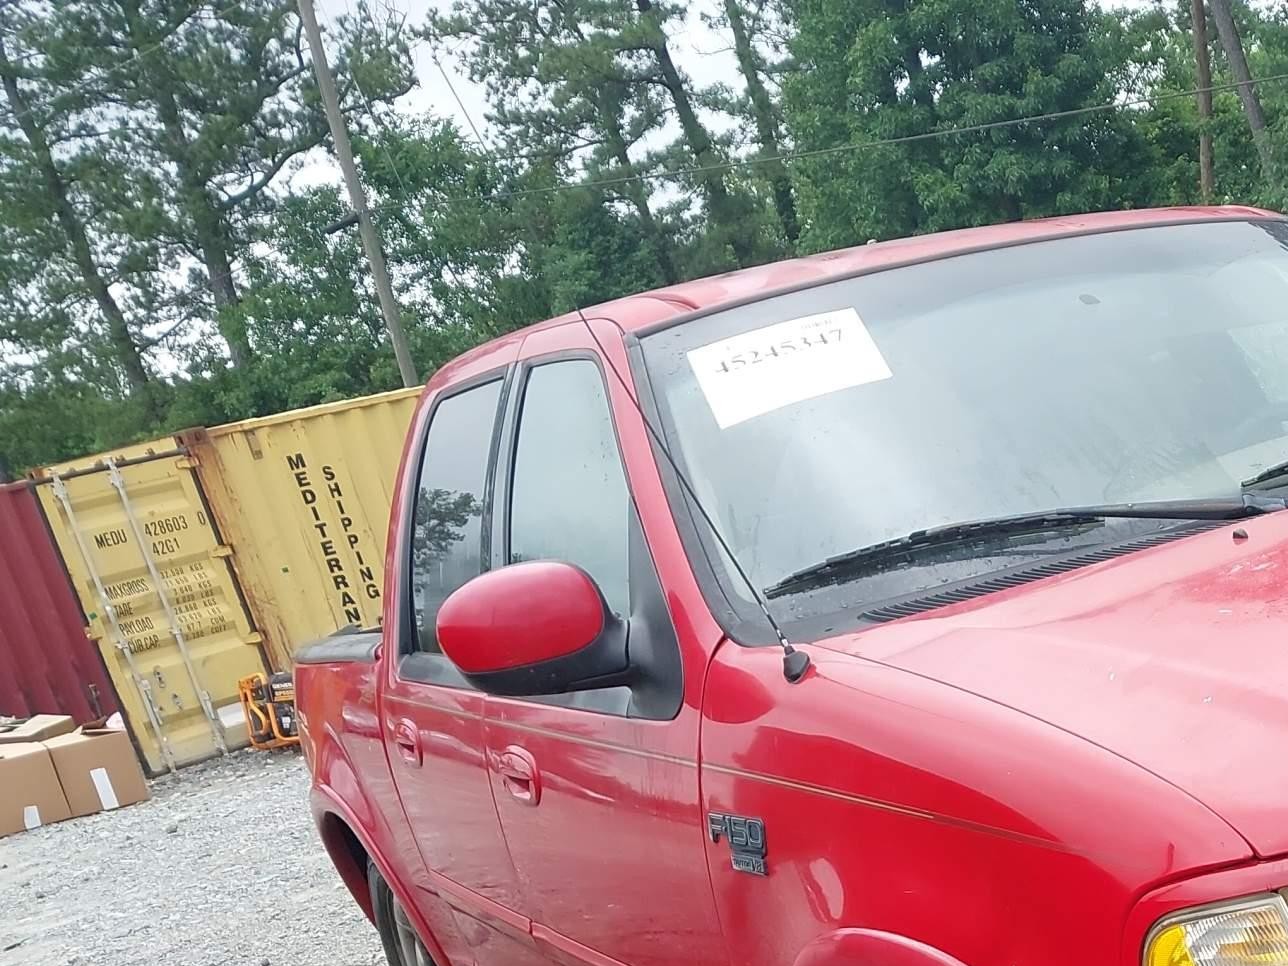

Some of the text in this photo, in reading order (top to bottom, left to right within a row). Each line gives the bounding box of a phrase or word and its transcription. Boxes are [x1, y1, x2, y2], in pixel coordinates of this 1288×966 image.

[94, 511, 206, 549] MEDU 428603 0
[287, 453, 362, 629] MEDITERRAN
[322, 466, 380, 599] SHIPPING
[152, 538, 180, 555] 42G1
[104, 578, 149, 600] MAXGROSS
[113, 601, 133, 618] TARE
[118, 616, 155, 637] PAYLOAD
